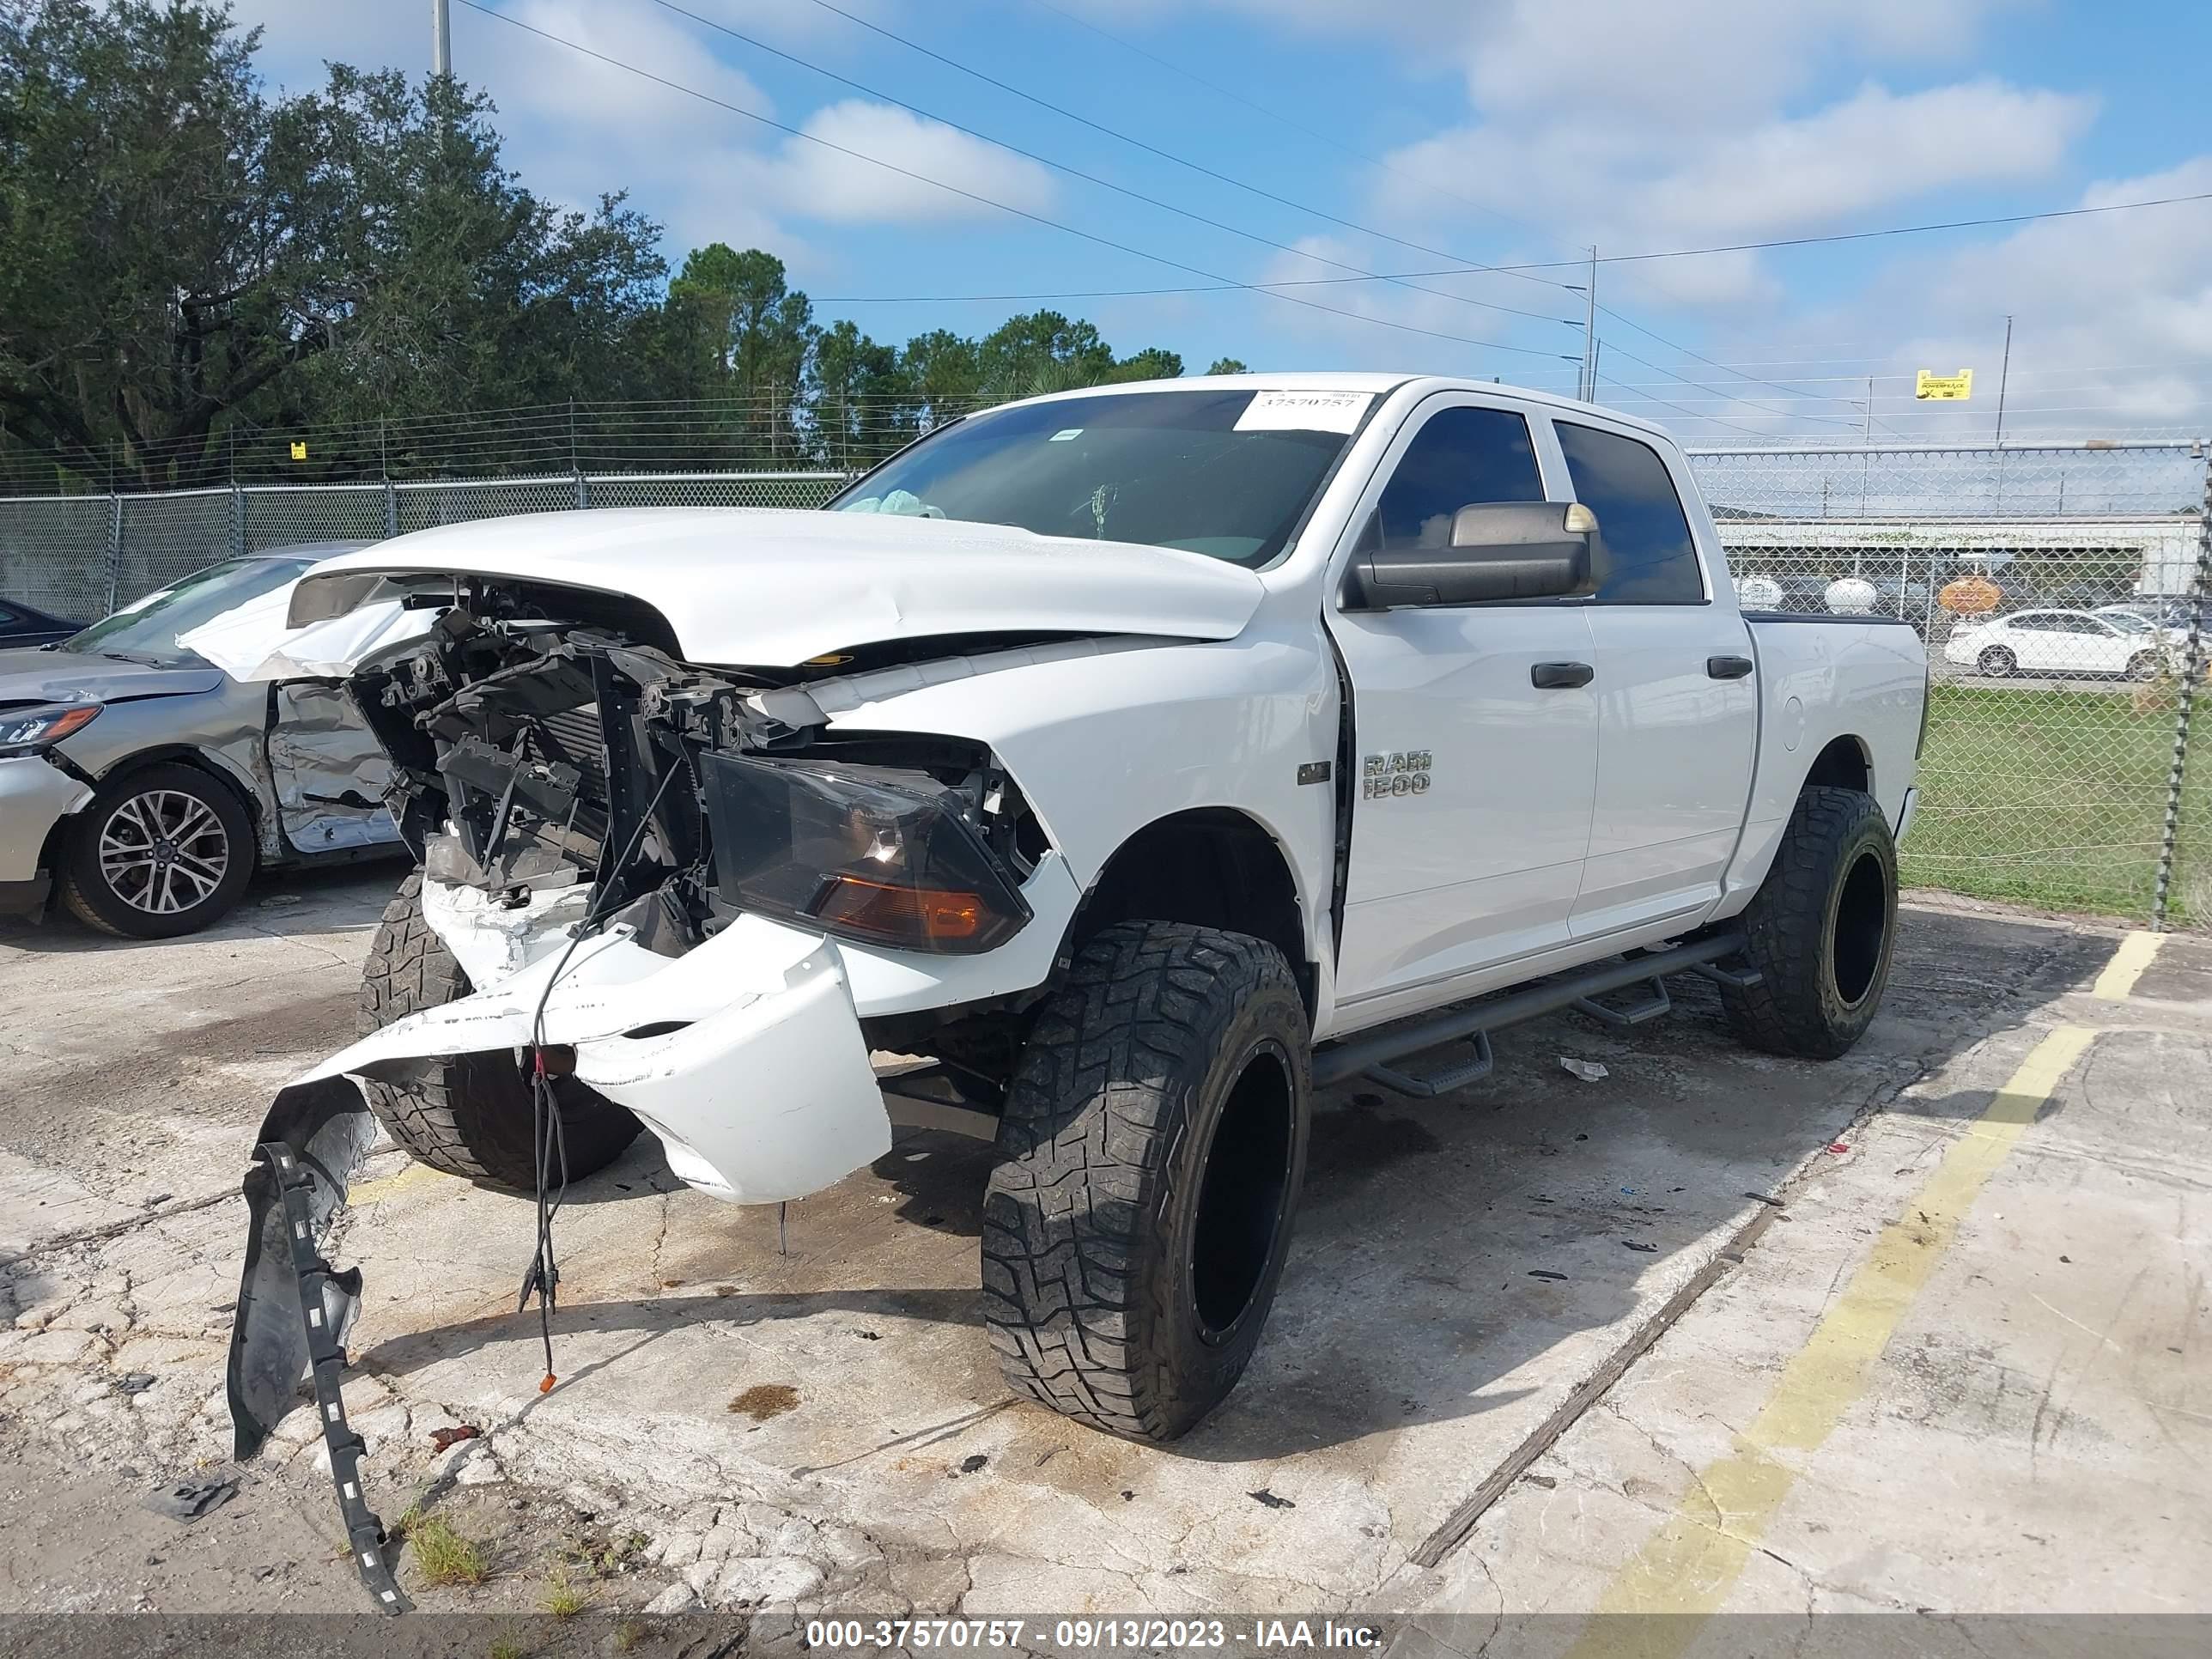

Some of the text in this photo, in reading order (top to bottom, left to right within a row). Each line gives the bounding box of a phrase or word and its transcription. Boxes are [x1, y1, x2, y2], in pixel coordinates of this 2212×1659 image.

[1261, 398, 1354, 407] 37570757
[1364, 750, 1432, 776] RAM
[1363, 773, 1431, 800] 1500
